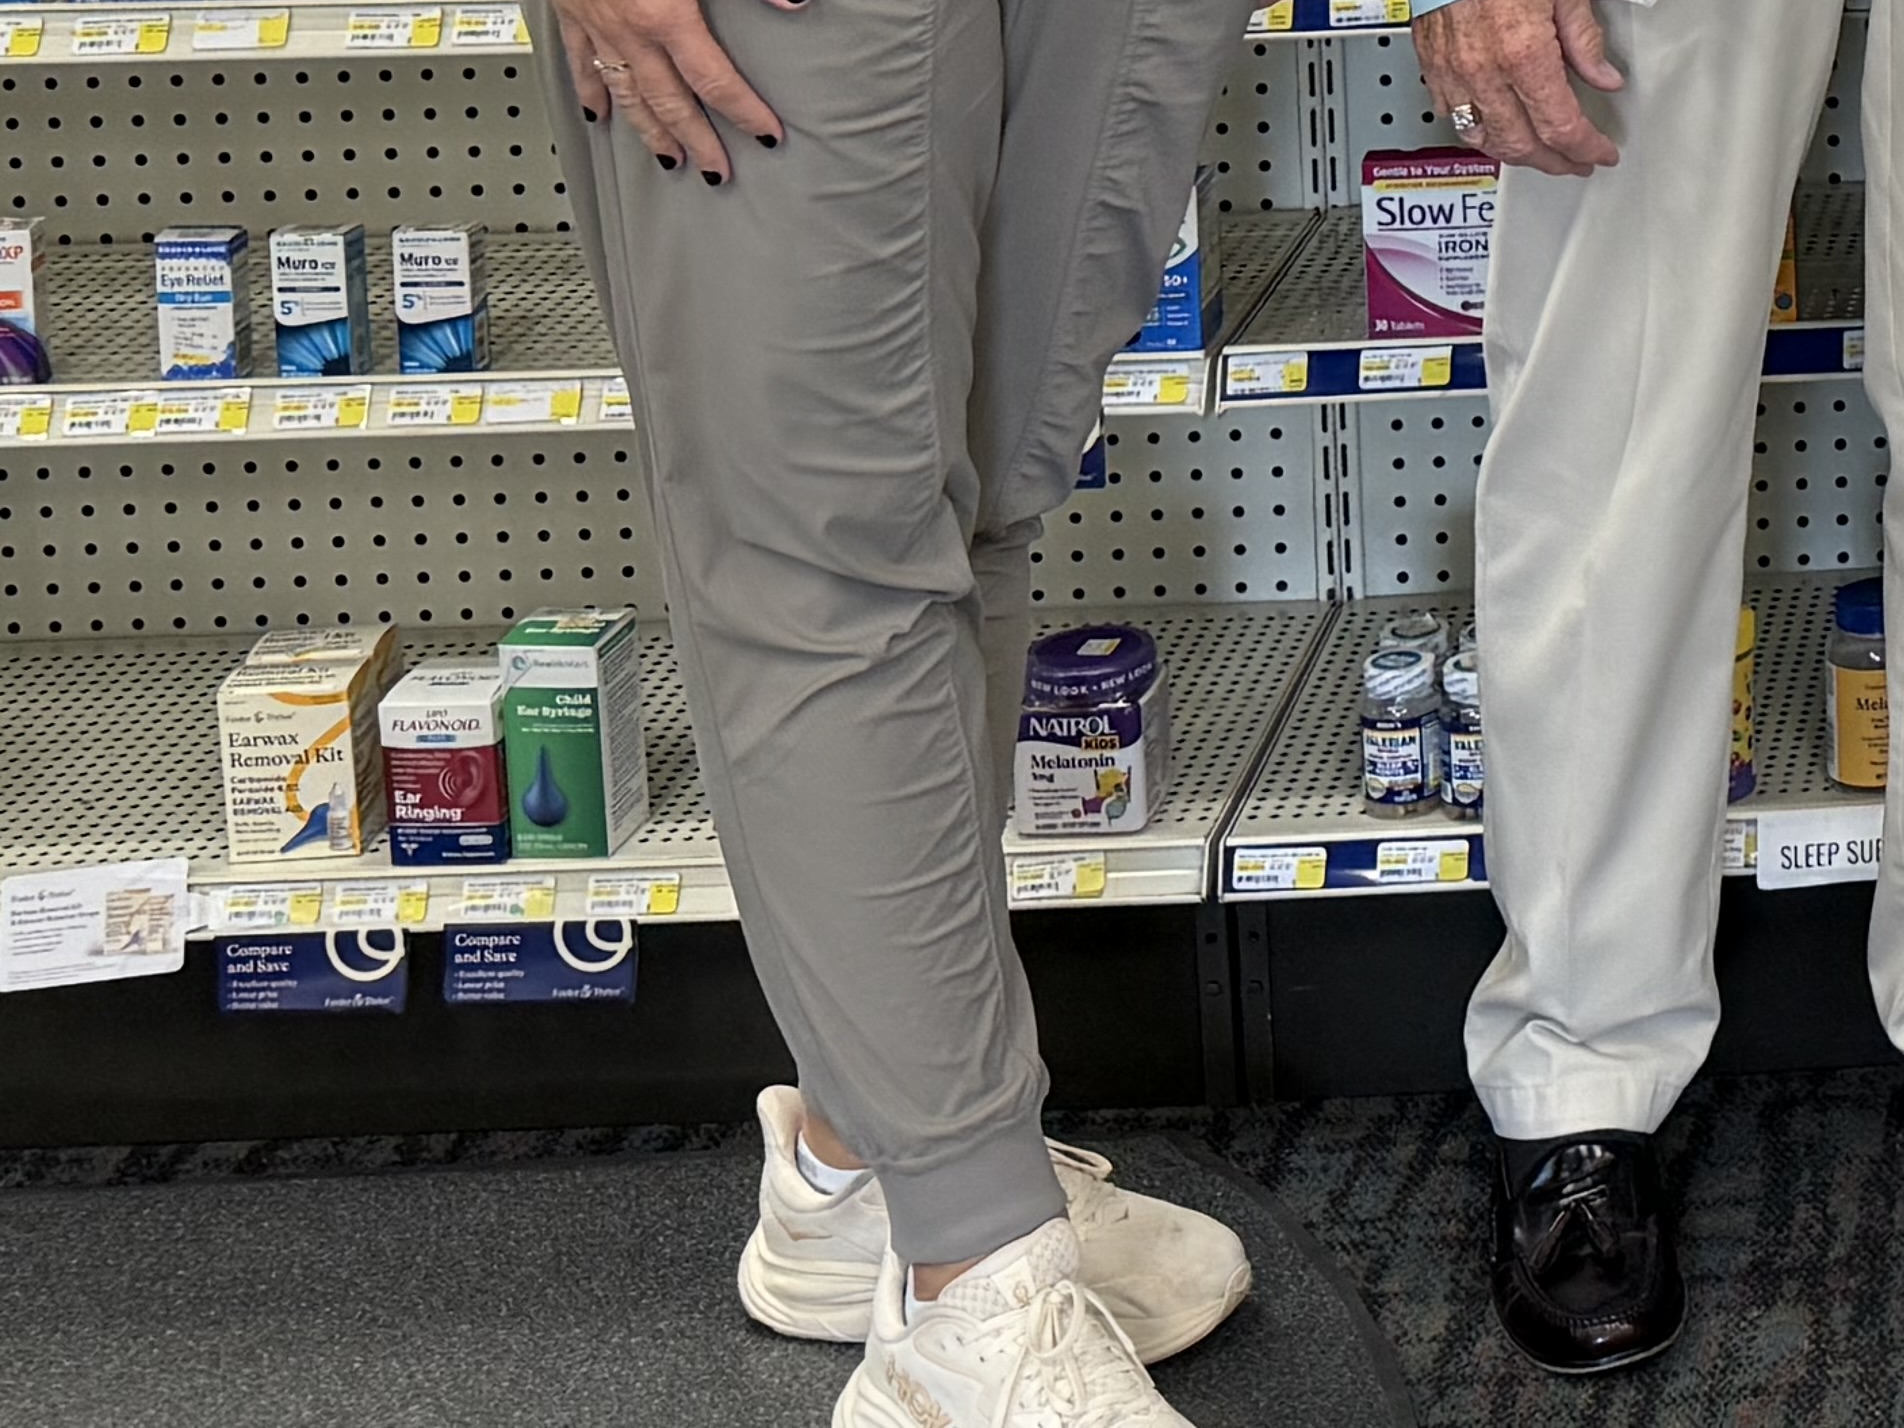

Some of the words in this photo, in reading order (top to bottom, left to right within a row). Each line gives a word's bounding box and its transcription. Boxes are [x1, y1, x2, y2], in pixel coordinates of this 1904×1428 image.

[1410, 166, 1423, 176] to
[1426, 166, 1450, 175] Your
[1454, 163, 1495, 175] System
[1376, 196, 1455, 226] Slow
[1462, 193, 1495, 223] Fe
[1438, 239, 1488, 254] IRON
[276, 256, 318, 271] Muro
[400, 253, 441, 266] Muro
[1375, 319, 1388, 331] 30
[1054, 685, 1089, 695] LOOK
[1101, 675, 1125, 689] NEW
[555, 695, 591, 705] Child
[517, 706, 539, 716] Ear
[392, 718, 481, 732] FLAVONOID
[1029, 716, 1116, 737] NATROL
[228, 732, 299, 748] Earwax
[230, 749, 310, 768] Removal
[315, 747, 344, 764] Kit
[1031, 753, 1115, 770] Melatonin
[394, 791, 422, 804] Ear
[395, 806, 463, 822] Ringing
[1780, 842, 1840, 870] SLEEP
[455, 933, 521, 949] Compare
[227, 943, 293, 960] Compare
[455, 950, 481, 963] and
[485, 949, 517, 963] Save
[227, 961, 254, 973] and
[257, 959, 289, 973] Save
